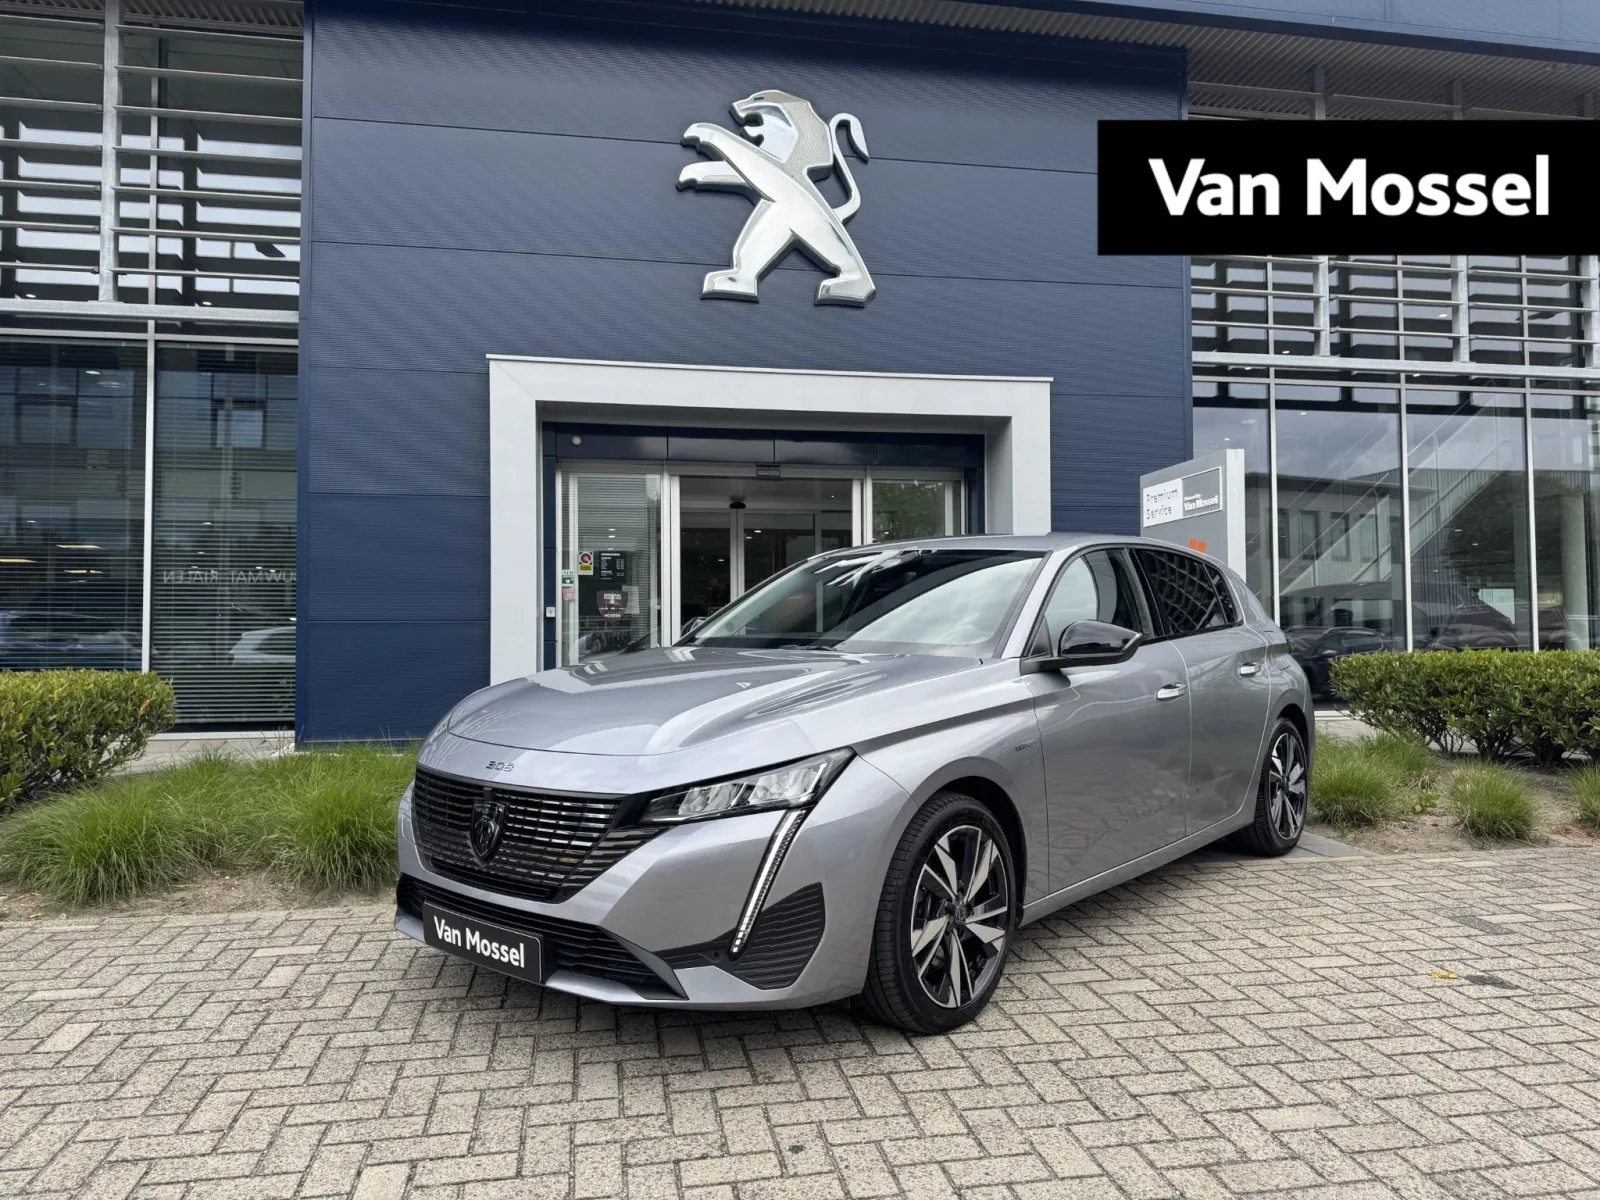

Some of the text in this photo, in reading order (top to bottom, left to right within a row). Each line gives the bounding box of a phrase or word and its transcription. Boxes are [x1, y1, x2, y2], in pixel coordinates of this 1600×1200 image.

[1146, 488, 1178, 503] Premium
[1146, 505, 1172, 520] Service
[486, 760, 515, 772] 308
[433, 915, 525, 968] Van Mossel
